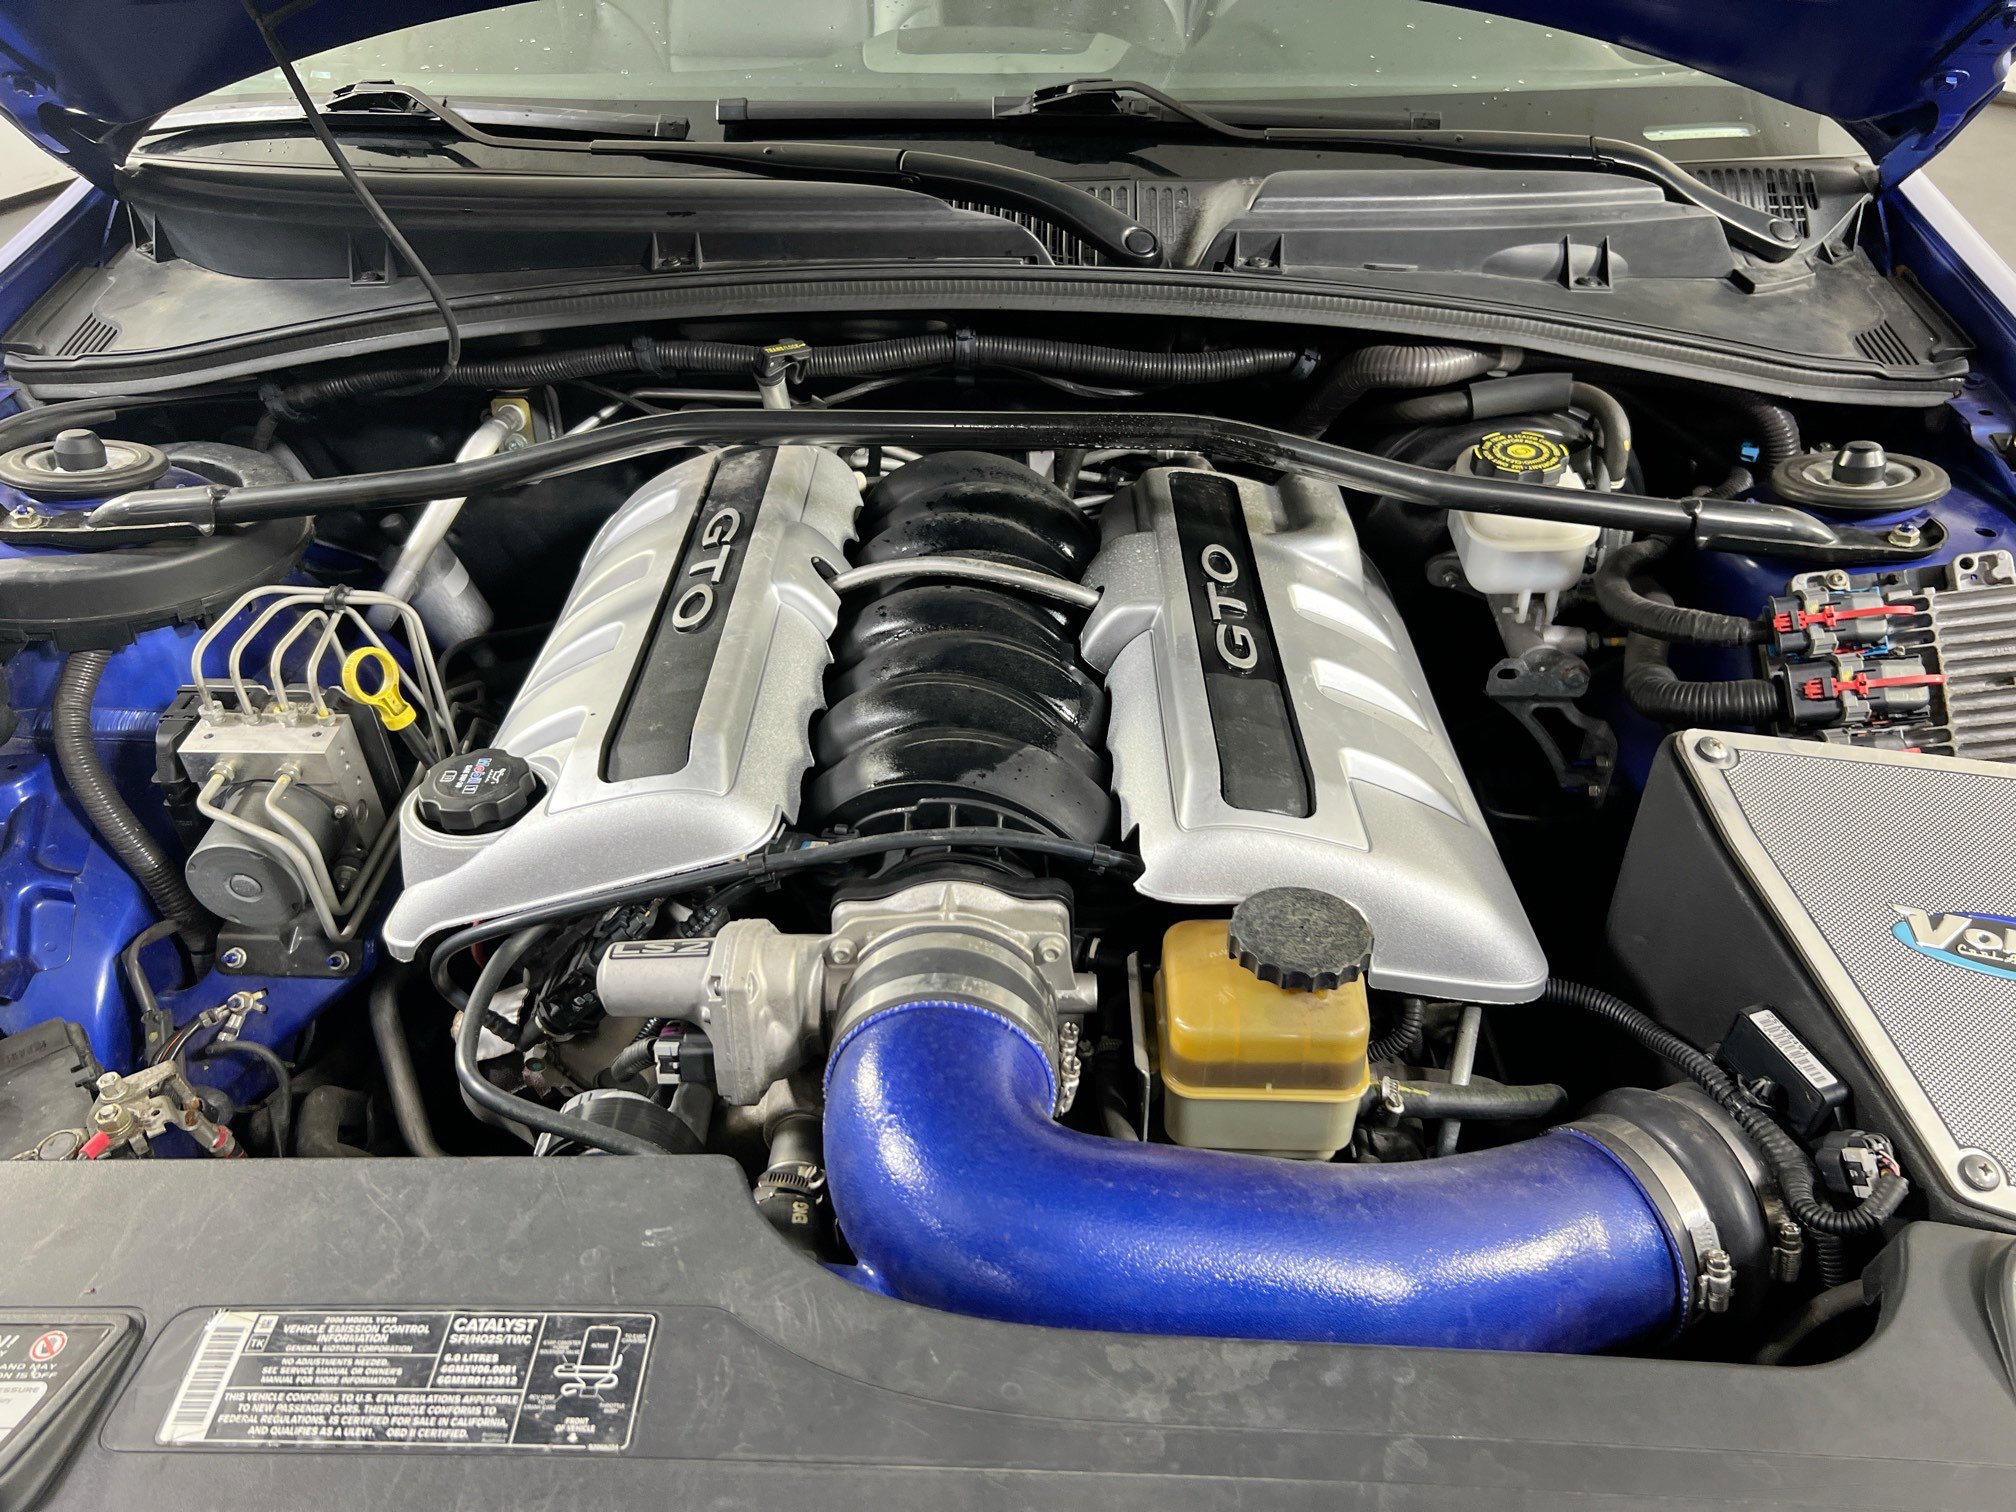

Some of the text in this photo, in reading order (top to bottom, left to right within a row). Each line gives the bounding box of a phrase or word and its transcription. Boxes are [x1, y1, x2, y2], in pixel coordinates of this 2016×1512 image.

[672, 507, 740, 631] GTO
[1201, 543, 1258, 669] GTO
[611, 942, 710, 955] LS2
[791, 1201, 809, 1224] ENG
[345, 1316, 374, 1324] MODEL
[375, 1316, 398, 1324] YEAR
[453, 1317, 538, 1333] CATALYST
[283, 1324, 430, 1334] VEHICLE EMISSION CONTROL
[250, 1337, 266, 1349] TK
[316, 1333, 390, 1343] INFORMATION
[448, 1333, 533, 1345] SFI/HO2S/TWC
[285, 1344, 413, 1353] GENERAL MOTORS CORPORATION
[281, 1357, 295, 1366] NO
[295, 1358, 353, 1366] ADJUSTMENTS
[443, 1353, 500, 1363] 6.0 LITRES
[29, 1362, 58, 1370] MAY
[261, 1366, 403, 1376] SEE SERVICE MANUAL OR OWNER'S
[260, 1375, 398, 1385] MANUAL FOR MORE INFORMATION
[224, 1392, 520, 1405] THIS VEHICLE CONFORMS TO U.S. EPA REGULATIONS APPLICABLE
[238, 1402, 497, 1416] TO NEW PASSENGER CARS. THIS VEHICLE CONFORMS TO
[217, 1413, 258, 1423] FEDERAL
[328, 1415, 340, 1425] IS
[340, 1415, 390, 1426] CERTIFIED
[390, 1416, 412, 1426] FOR
[412, 1416, 437, 1427] SALE
[437, 1416, 450, 1427] IN
[564, 1416, 590, 1425] FRONT
[247, 1425, 269, 1435] AND
[269, 1426, 319, 1436] QUALIFIES
[319, 1426, 334, 1437] AS
[333, 1427, 343, 1437] A
[385, 1427, 408, 1438] OBD
[417, 1428, 469, 1440] CERTIFIED.
[554, 1424, 596, 1433] OF VEHICLE
